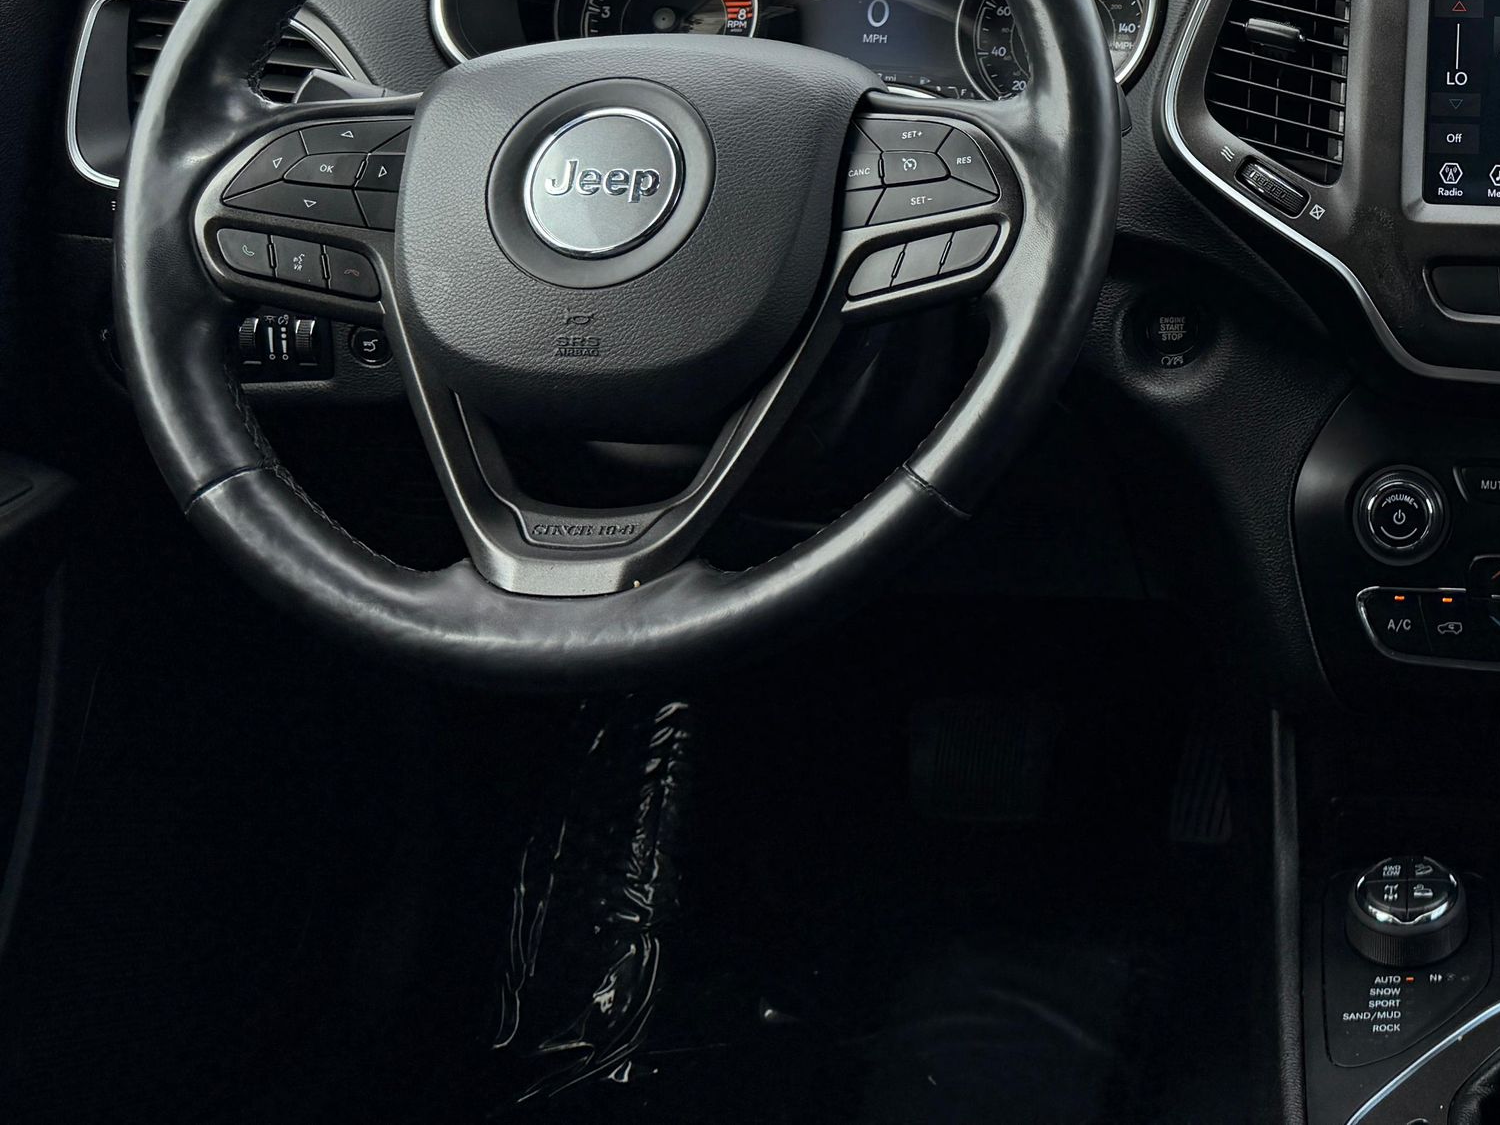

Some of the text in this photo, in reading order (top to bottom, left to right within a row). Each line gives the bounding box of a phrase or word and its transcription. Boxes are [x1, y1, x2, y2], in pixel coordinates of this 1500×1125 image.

[601, 6, 611, 18] 3
[738, 8, 747, 20] 8
[996, 7, 1011, 16] 60
[727, 20, 748, 28] RPM
[1119, 22, 1136, 33] 140
[863, 33, 887, 44] MPH
[991, 46, 1007, 57] 40
[1446, 72, 1468, 86] LO
[1012, 80, 1027, 91] 20
[902, 130, 923, 139] SET+
[1446, 133, 1463, 144] Off
[956, 156, 972, 165] RES
[319, 163, 334, 173] OK
[848, 168, 871, 177] CANC
[544, 159, 661, 203] Jeep
[1438, 187, 1463, 197] Radio
[1159, 316, 1186, 324] ENGINE
[556, 336, 600, 347] SRS
[1162, 333, 1183, 341] STOP
[554, 348, 600, 357] AIRBAG
[1386, 493, 1415, 505] VOLUME
[532, 524, 592, 536] SINCE
[1387, 619, 1411, 632] A/C
[1374, 976, 1401, 984] AUTO
[1369, 987, 1401, 996] SNOW
[1368, 999, 1401, 1008] SPORT
[1343, 1011, 1401, 1021] SAND/MUD
[1373, 1024, 1401, 1032] ROCK
